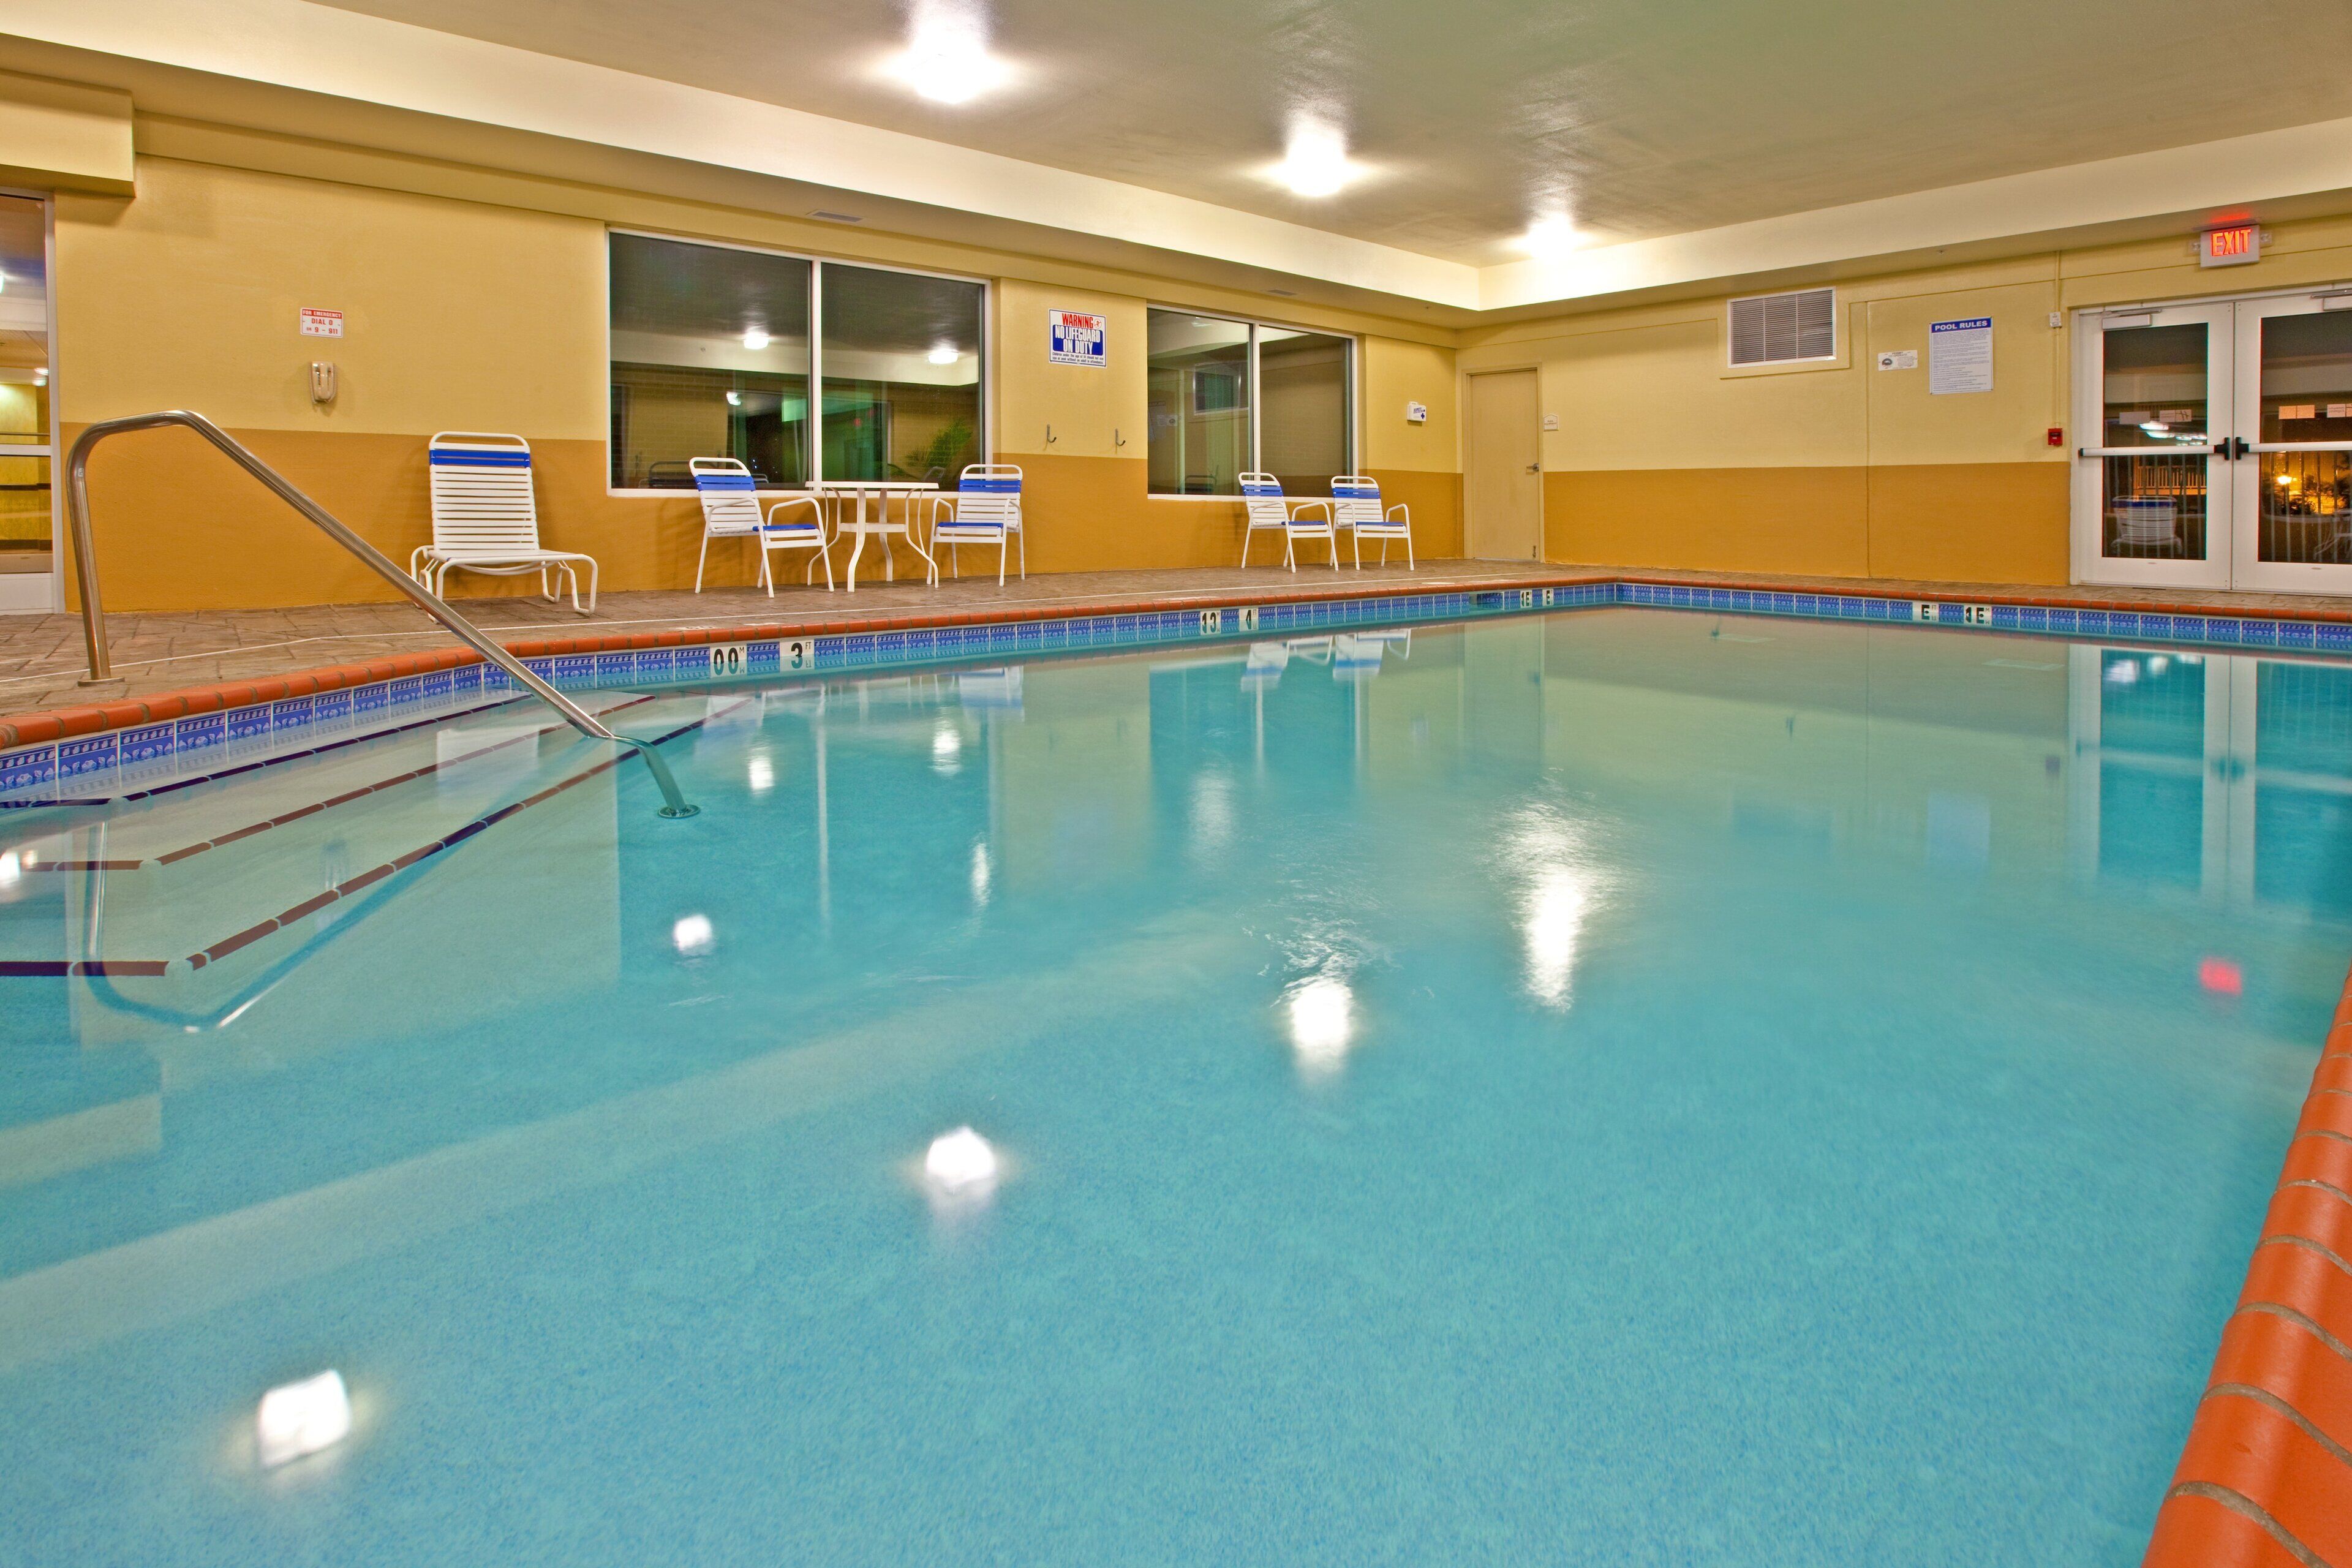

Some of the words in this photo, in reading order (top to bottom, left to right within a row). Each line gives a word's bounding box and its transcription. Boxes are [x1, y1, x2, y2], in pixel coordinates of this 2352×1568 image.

[2211, 228, 2252, 256] EXIT
[1061, 313, 1093, 328] WARNING
[1055, 325, 1065, 339] NO
[1066, 326, 1101, 343] LIFEGUARD
[1063, 339, 1072, 352] ON
[1075, 340, 1093, 355] DUTY
